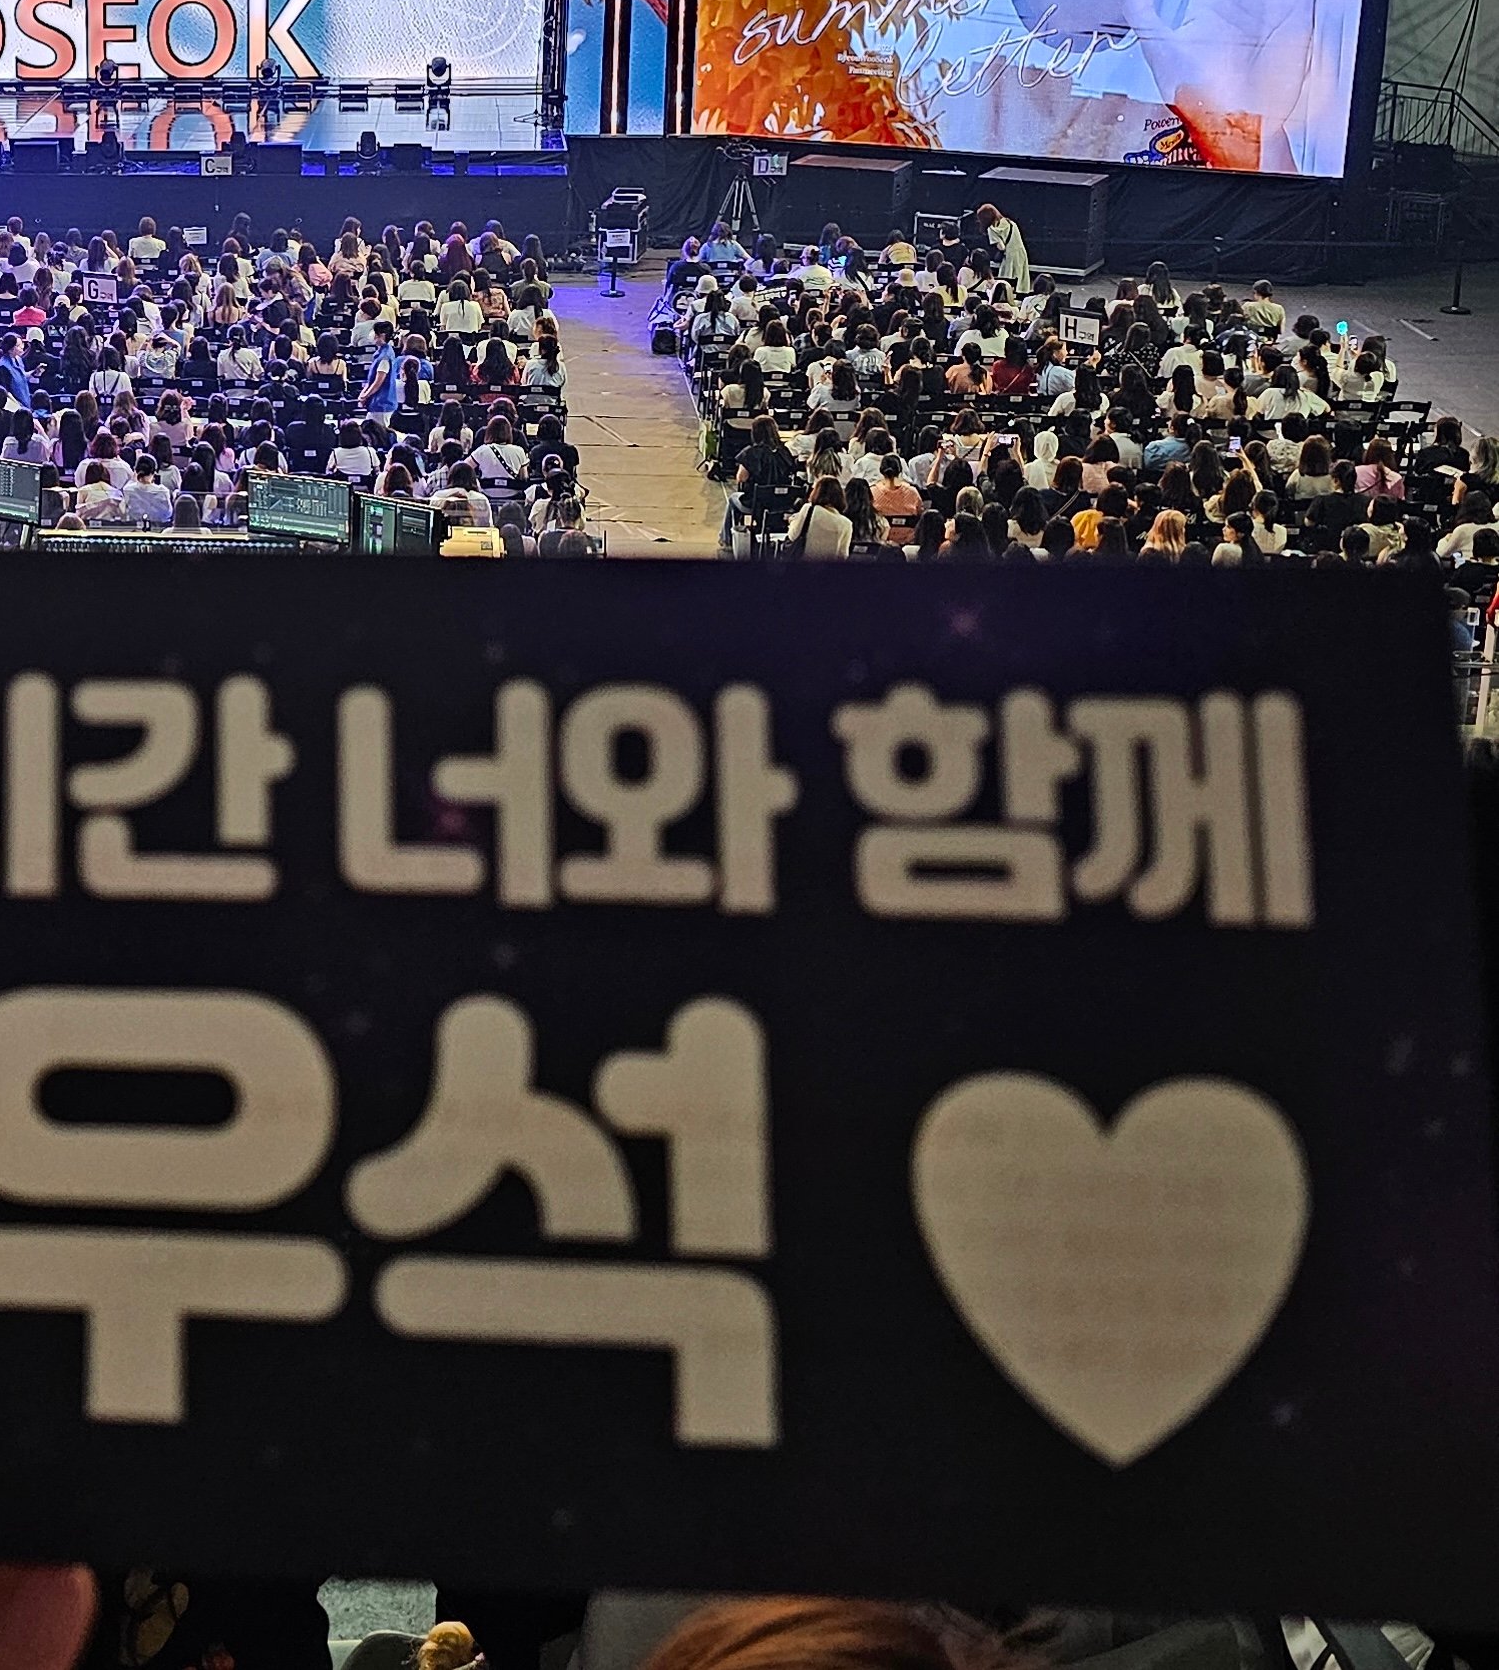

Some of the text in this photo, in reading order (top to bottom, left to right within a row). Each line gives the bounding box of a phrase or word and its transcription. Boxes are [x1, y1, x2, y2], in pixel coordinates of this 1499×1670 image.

[895, 4, 1139, 108] letter
[334, 676, 799, 914] 너와
[831, 680, 1315, 932] 함께
